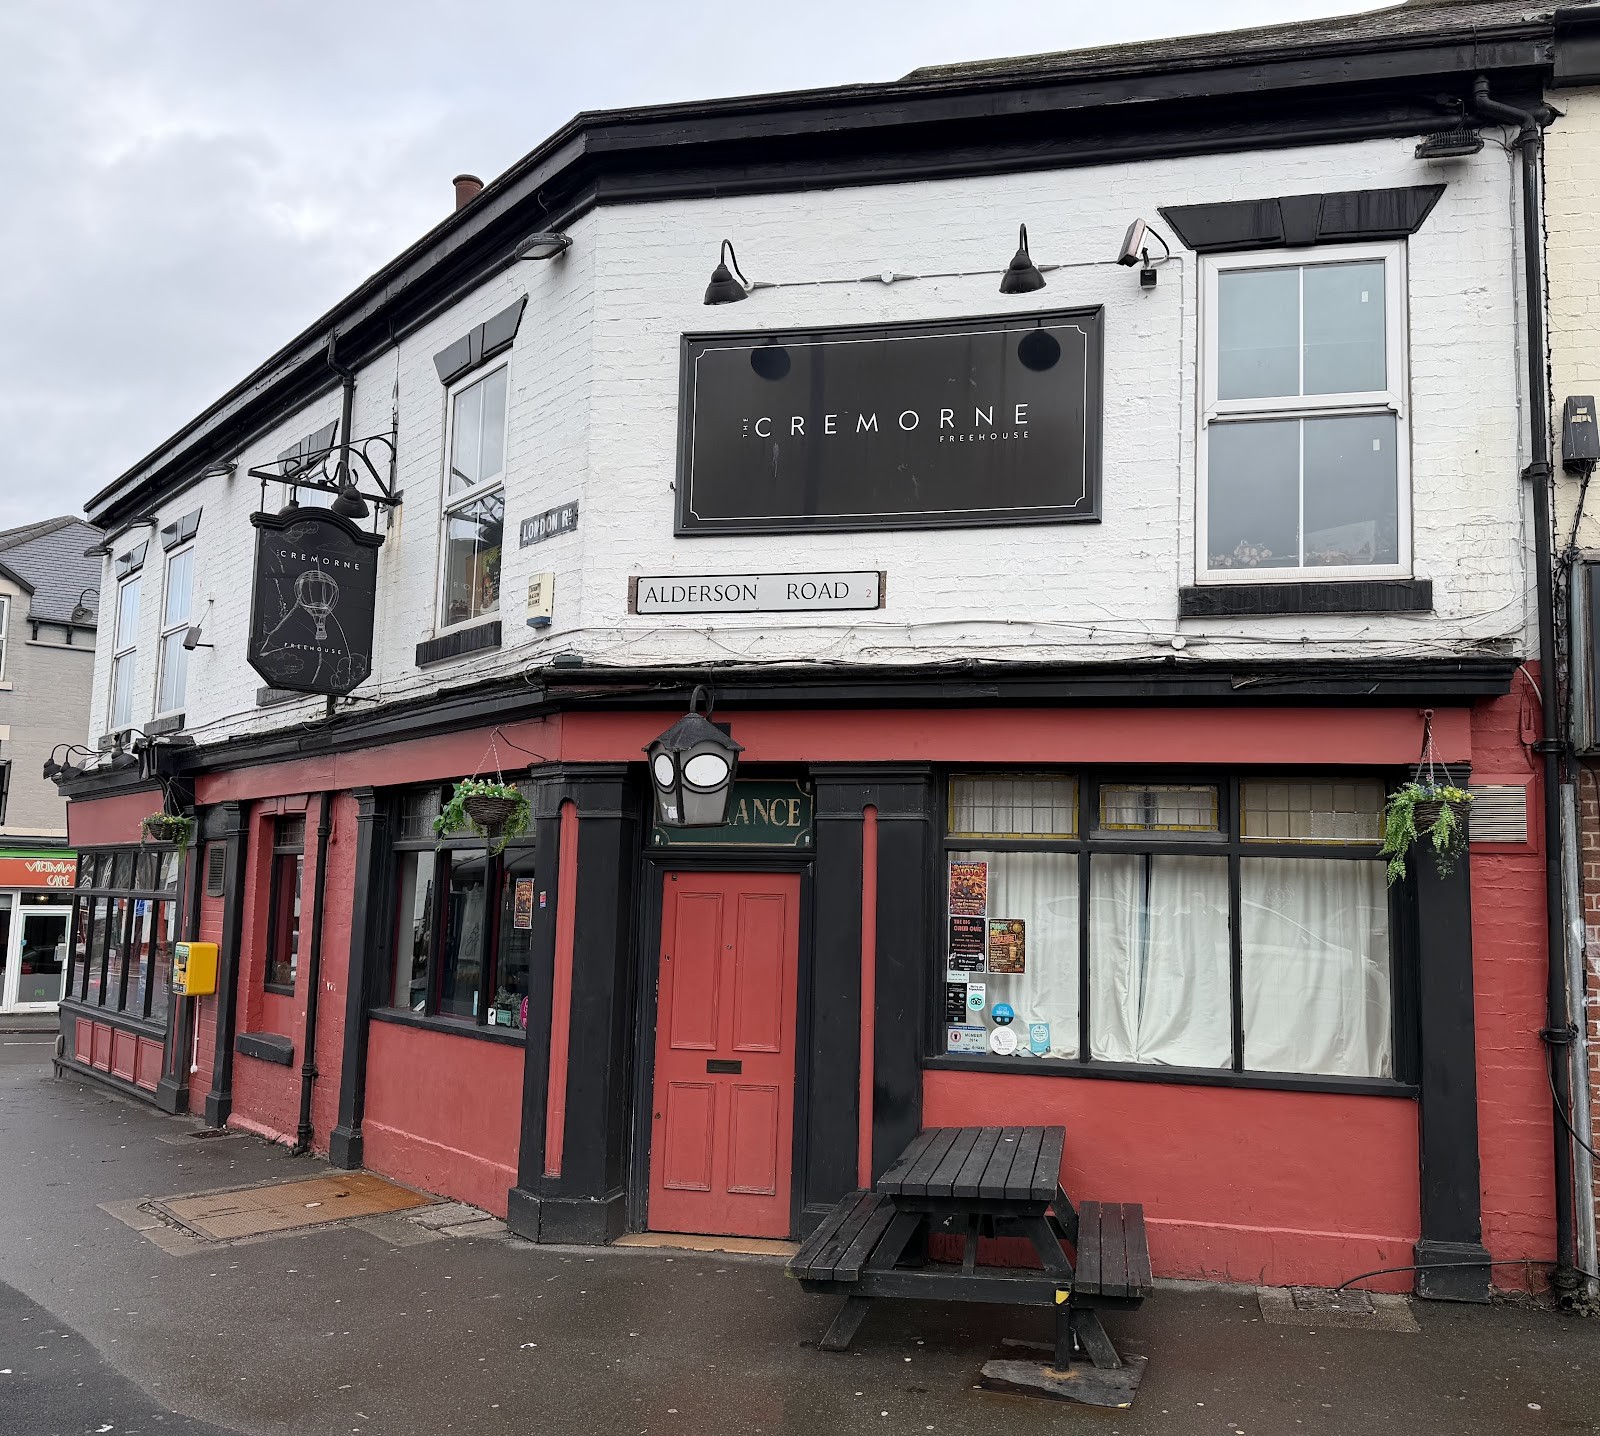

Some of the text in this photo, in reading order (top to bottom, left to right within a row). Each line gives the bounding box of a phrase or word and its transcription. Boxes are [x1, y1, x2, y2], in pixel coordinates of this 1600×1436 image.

[755, 403, 1029, 438] CREMORNE
[939, 430, 1029, 443] FREEHOUSE
[522, 512, 558, 542] LONDON
[280, 550, 360, 571] CREMORNE
[644, 582, 872, 604] ALDERSON ROAD 2
[284, 642, 342, 655] FREEHOUSE
[727, 798, 801, 827] ANCE
